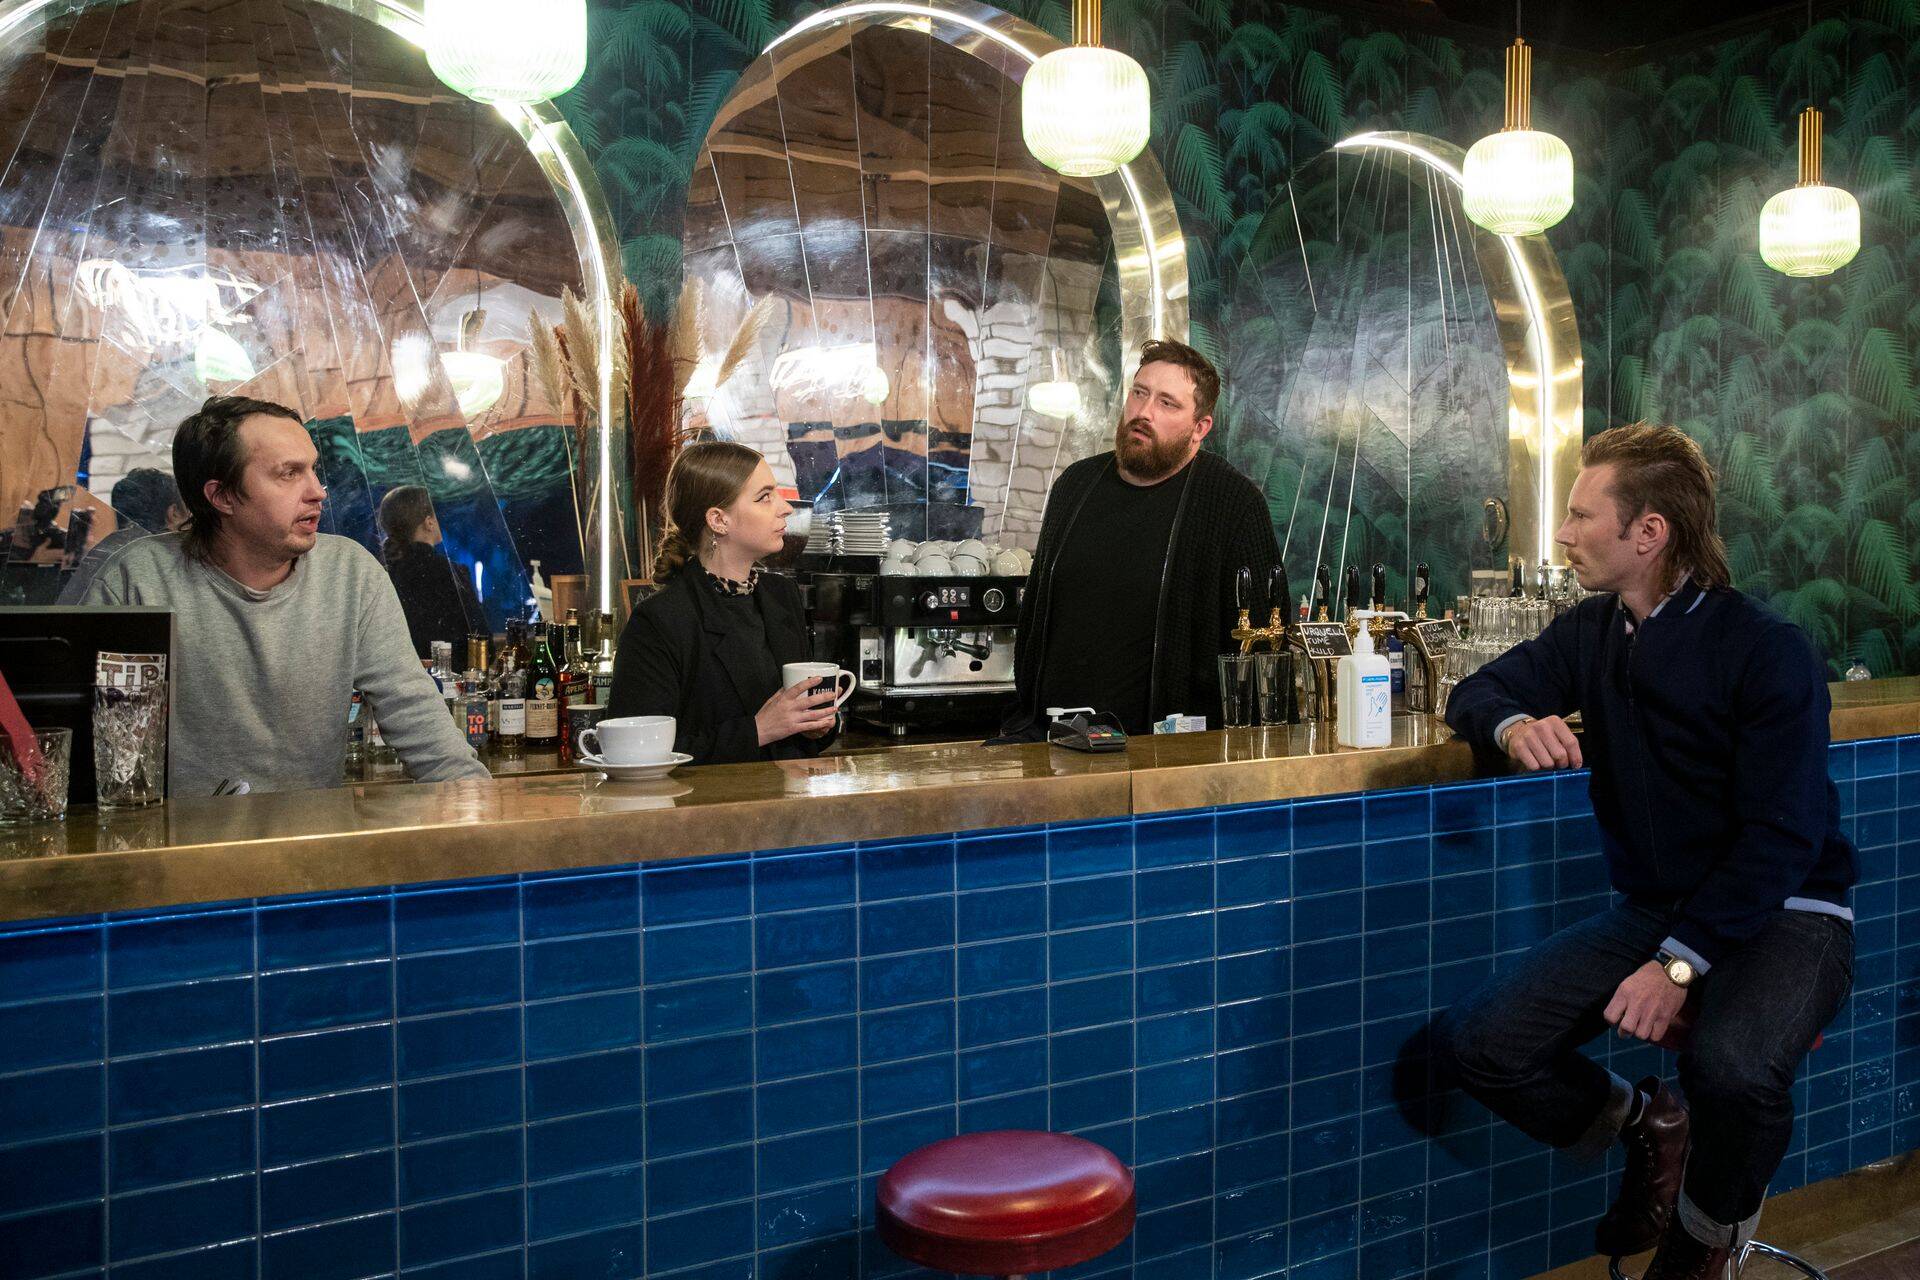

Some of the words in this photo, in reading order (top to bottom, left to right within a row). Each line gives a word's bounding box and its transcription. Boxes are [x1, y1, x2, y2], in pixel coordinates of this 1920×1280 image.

[593, 677, 612, 686] CAMP
[565, 683, 587, 694] APERO
[468, 714, 485, 725] TO
[469, 725, 484, 735] HI
